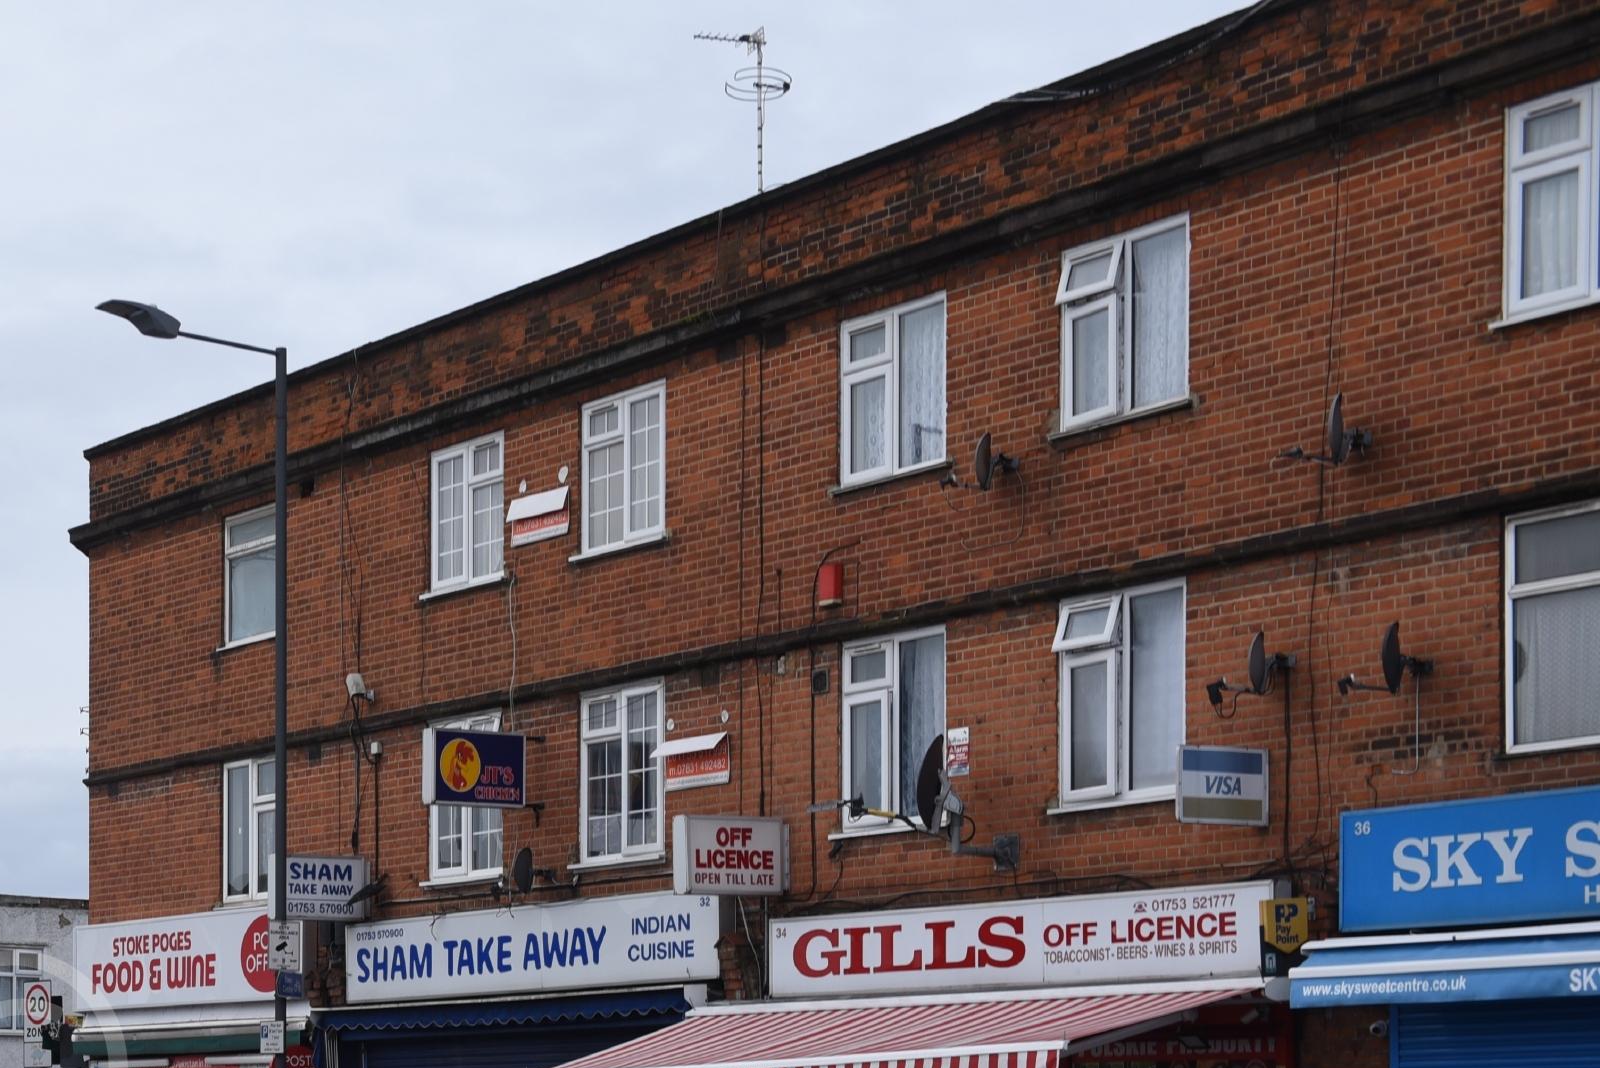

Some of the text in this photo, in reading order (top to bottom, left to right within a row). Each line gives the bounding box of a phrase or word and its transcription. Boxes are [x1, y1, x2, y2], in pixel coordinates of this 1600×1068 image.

[1205, 775, 1242, 796] VISA
[716, 826, 753, 848] OFF
[1354, 820, 1372, 836] 36
[695, 848, 774, 870] LICENCE
[1392, 827, 1533, 893] SKY
[289, 861, 353, 882] SHAM
[694, 871, 775, 886] OPEN TILL LATE
[288, 882, 354, 897] TAKE AWAY
[288, 901, 354, 915] 01753 570900
[699, 896, 711, 908] 32
[1151, 894, 1236, 912] 01753 521777
[356, 928, 404, 942] 01753 570900
[631, 913, 691, 936] INDIAN
[775, 926, 787, 940] 34
[1043, 911, 1238, 948] OFF LICENCE
[1276, 924, 1292, 936] Pay
[112, 930, 192, 958] STOKE POGES
[792, 915, 1026, 979] GILLS
[1276, 933, 1300, 945] Point
[357, 926, 608, 983] SHAM TAKE AWAY
[627, 940, 695, 963] CUISINE
[1043, 939, 1238, 965] TOBACCONIST BEERS WINES & SPIRITS
[92, 953, 216, 994] FOOD & WINE
[1302, 975, 1467, 998] www.skysweetcentre.co.uk
[30, 997, 46, 1012] 20
[26, 1027, 43, 1038] ZON
